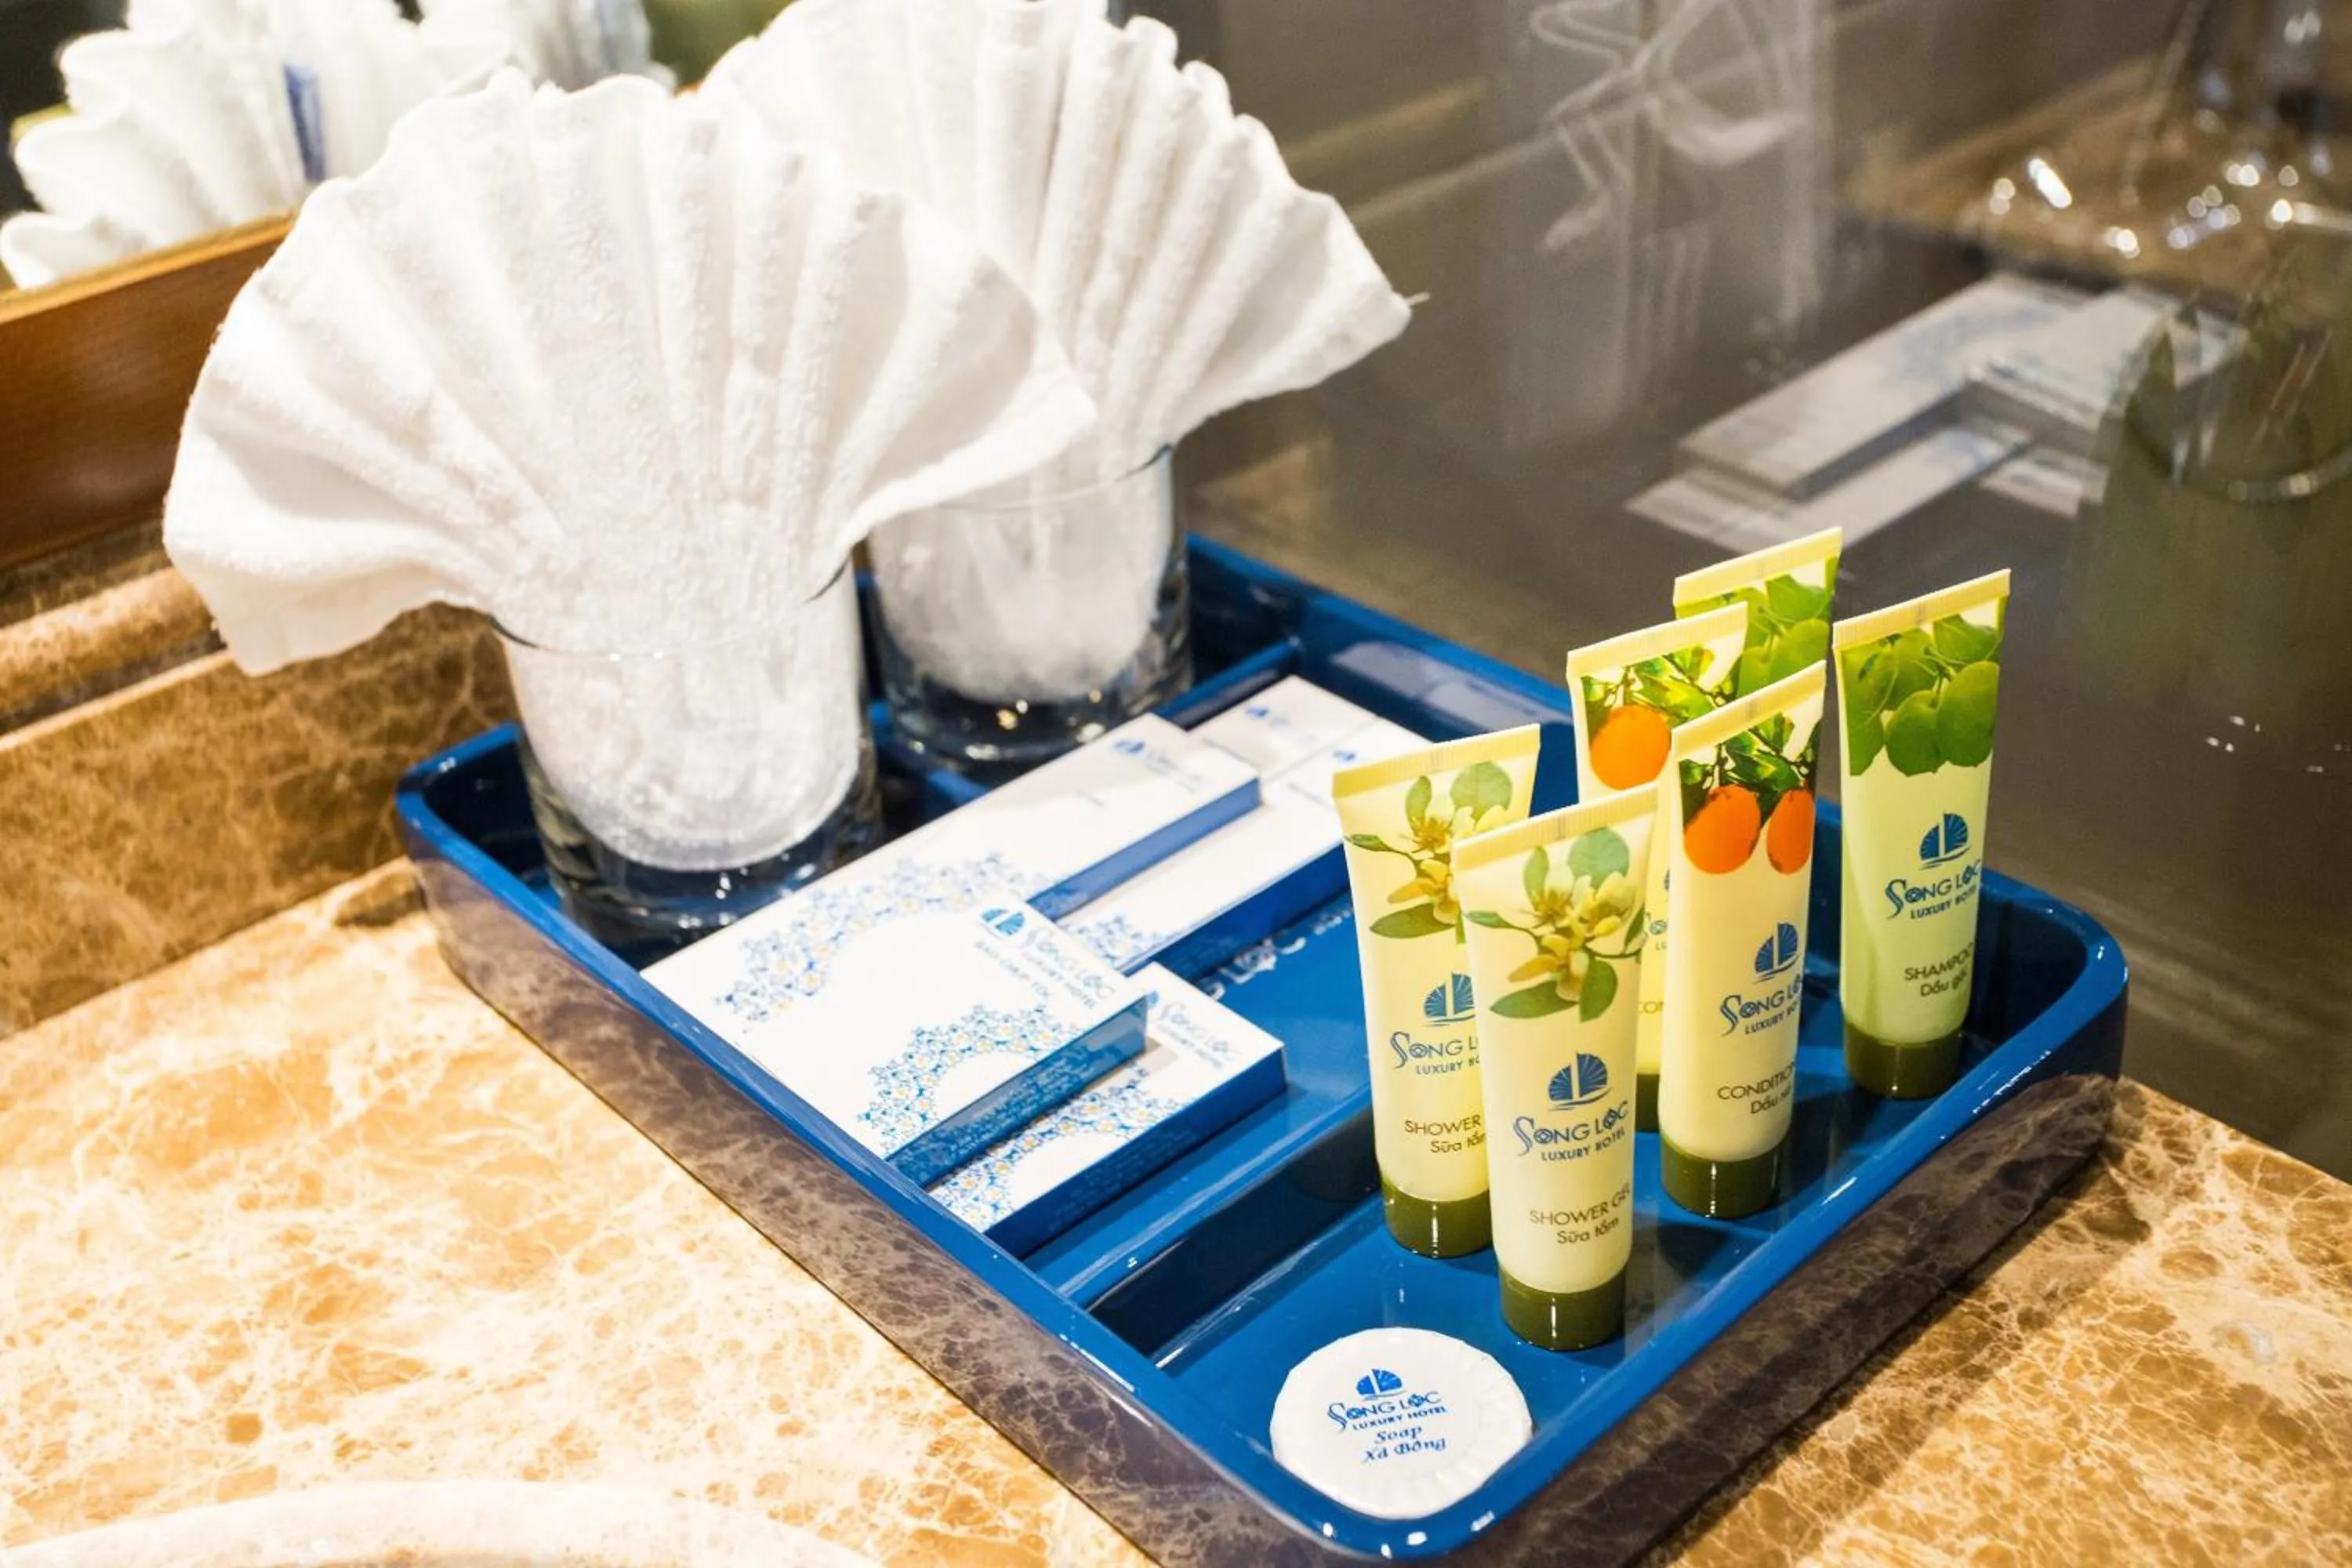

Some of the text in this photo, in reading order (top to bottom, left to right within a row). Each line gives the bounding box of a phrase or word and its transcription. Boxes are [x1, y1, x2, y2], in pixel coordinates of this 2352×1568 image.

[1885, 879, 1952, 920] SONG
[1910, 898, 1953, 920] LUXURY
[1719, 993, 1785, 1037] SONG
[1744, 1010, 1785, 1035] LUXURY
[1390, 1031, 1464, 1069] SONG
[1415, 1062, 1465, 1075] LUXURY
[1404, 1114, 1482, 1136] SHOWER
[1513, 1099, 1628, 1157] SONG LOC
[1541, 1145, 1591, 1162] LUXURY
[1529, 1201, 1610, 1225] SHOWER
[1327, 1390, 1442, 1434] SONG LOC
[1352, 1405, 1446, 1431] LUXURY HOTEL
[1374, 1426, 1422, 1444] Soap
